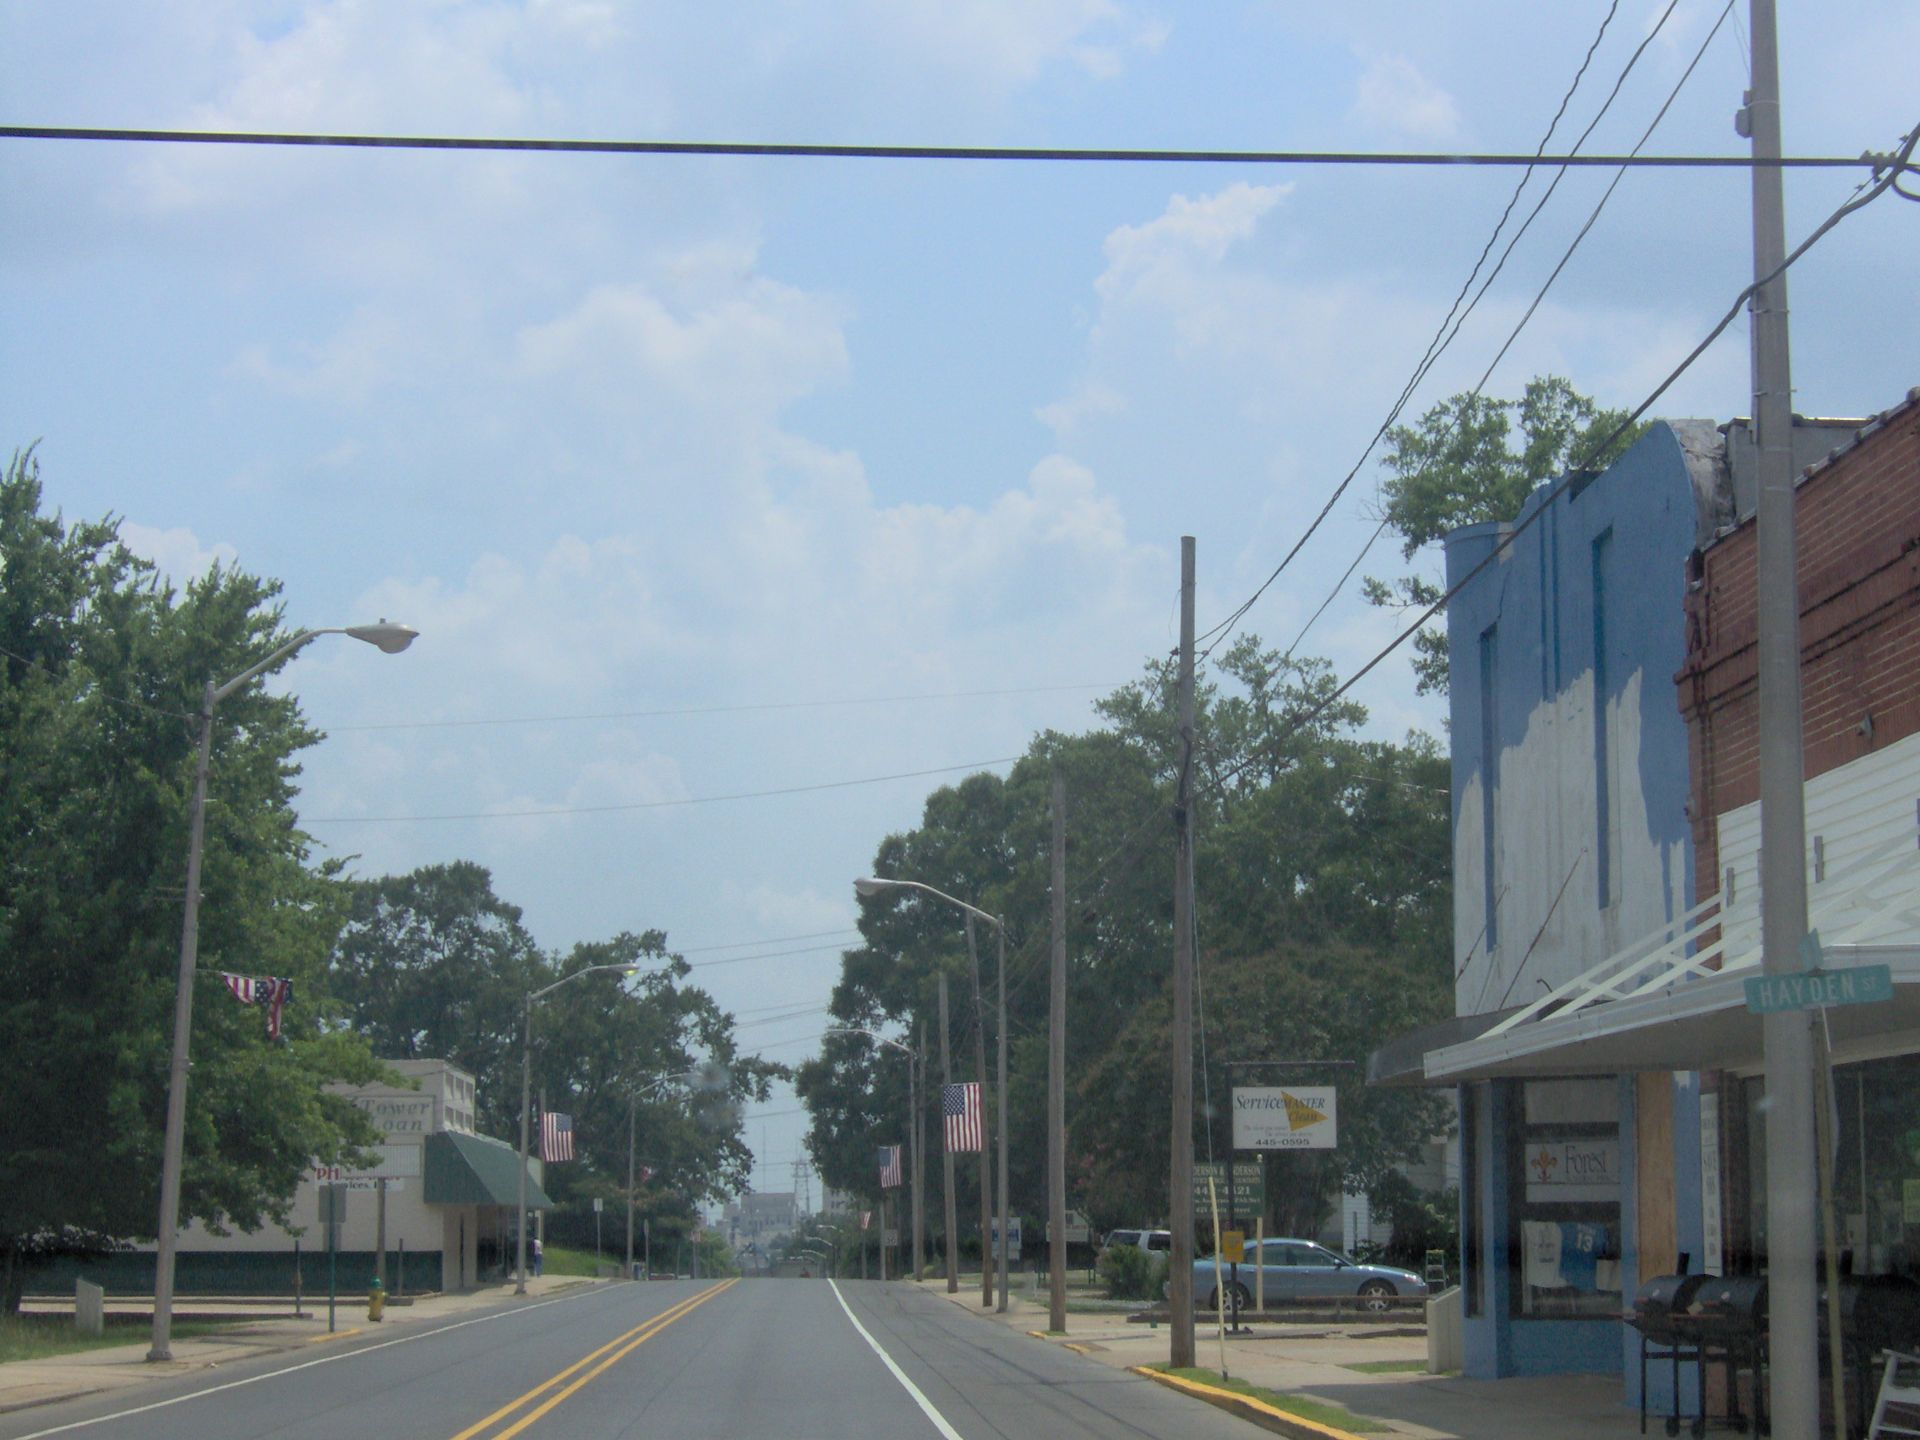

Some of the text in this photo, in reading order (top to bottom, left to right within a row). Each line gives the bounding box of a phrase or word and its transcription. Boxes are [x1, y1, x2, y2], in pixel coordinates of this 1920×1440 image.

[1760, 975, 1876, 1007] HAYDEN ST
[360, 1099, 430, 1115] Tower
[1255, 1138, 1310, 1146] 445-0595
[1564, 1144, 1607, 1174] Forest
[1575, 1232, 1594, 1253] 13
